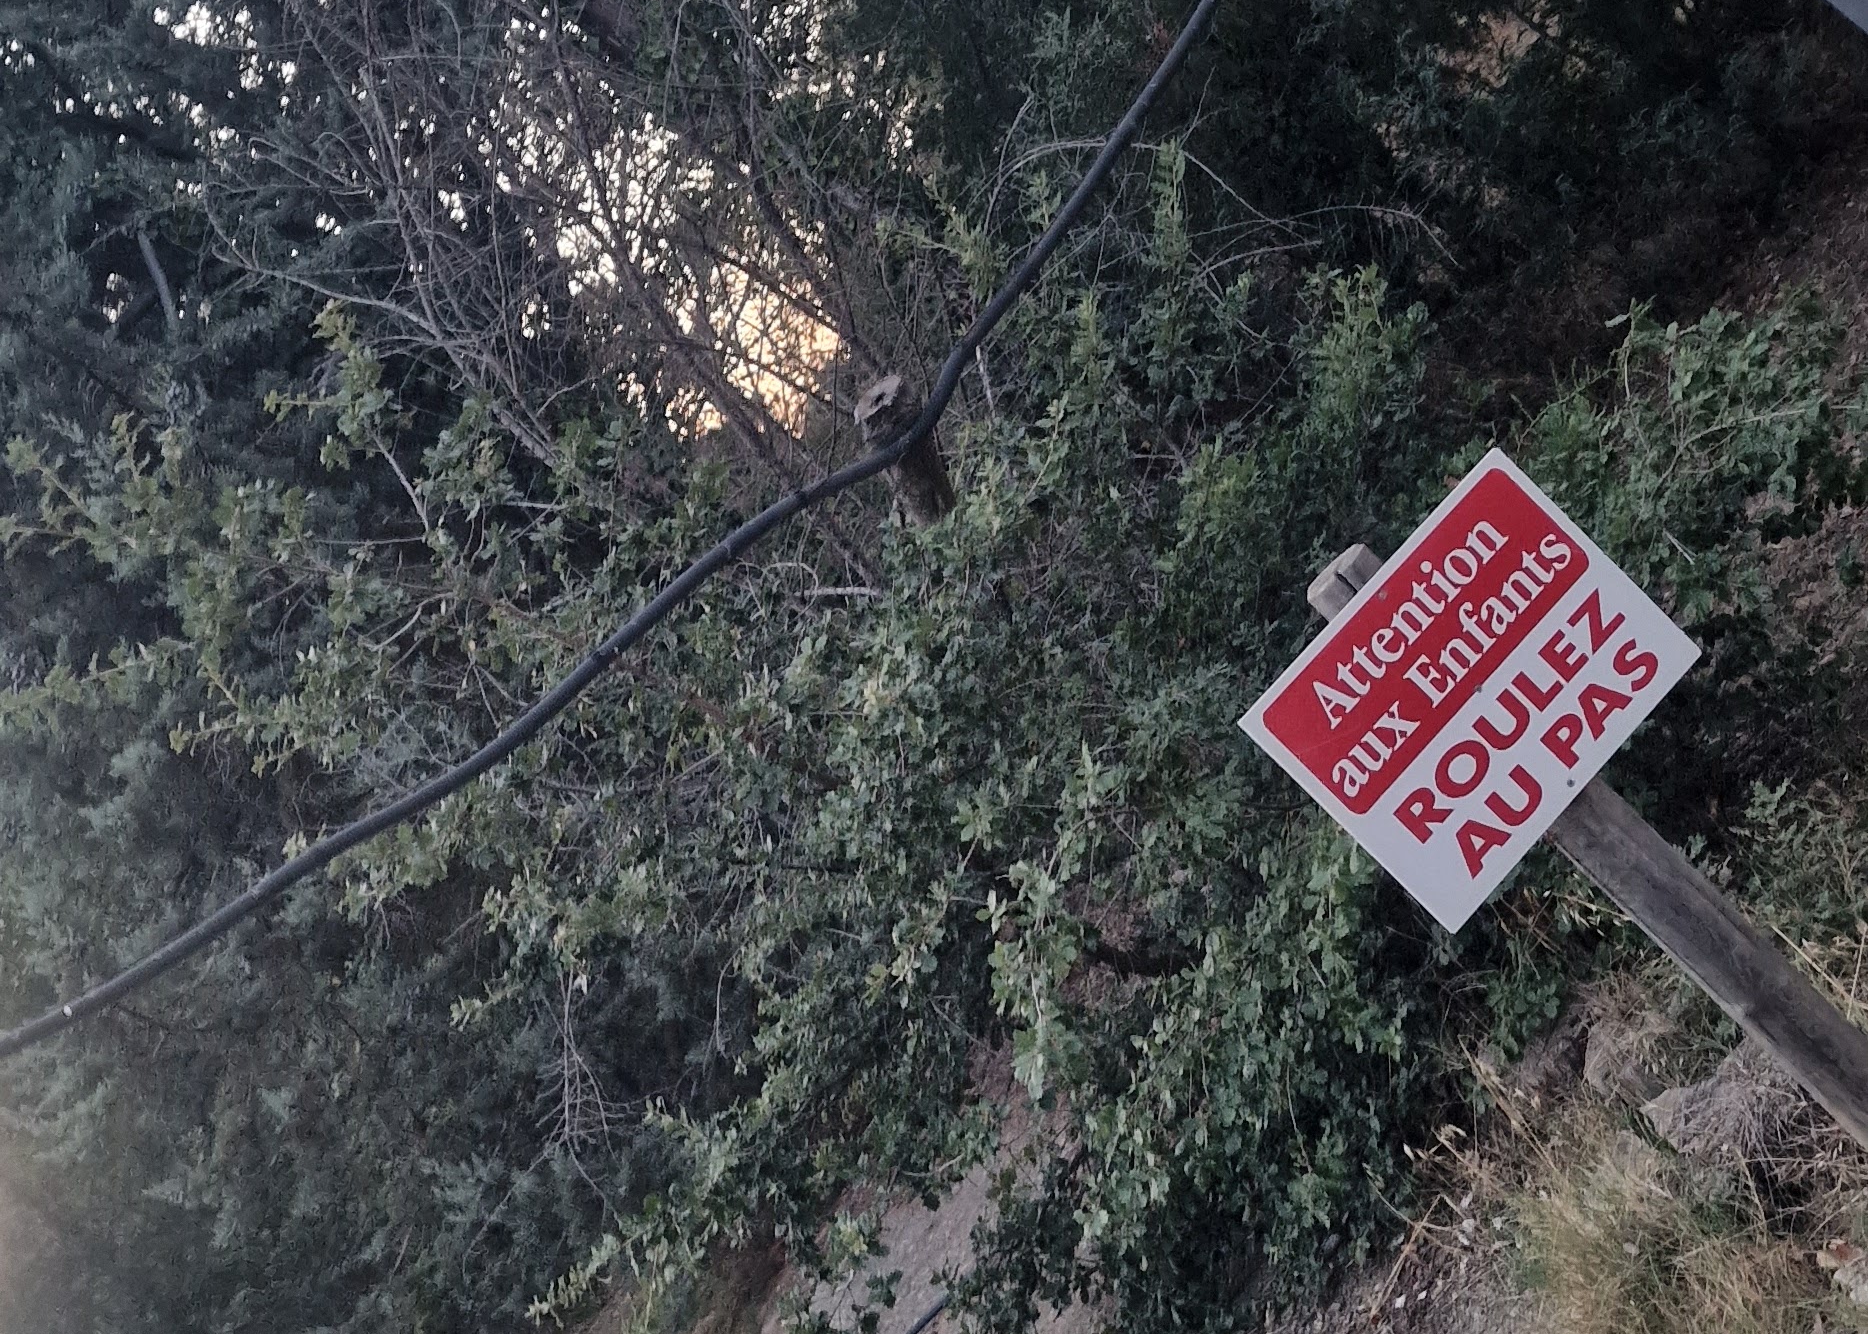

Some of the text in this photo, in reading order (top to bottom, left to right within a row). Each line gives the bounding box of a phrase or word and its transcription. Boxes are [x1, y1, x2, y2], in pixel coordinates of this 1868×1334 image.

[1310, 519, 1510, 730] Attention
[1331, 532, 1571, 798] aux Enfants
[1392, 589, 1625, 844] ROULEZ
[1455, 637, 1659, 880] AU PAS
